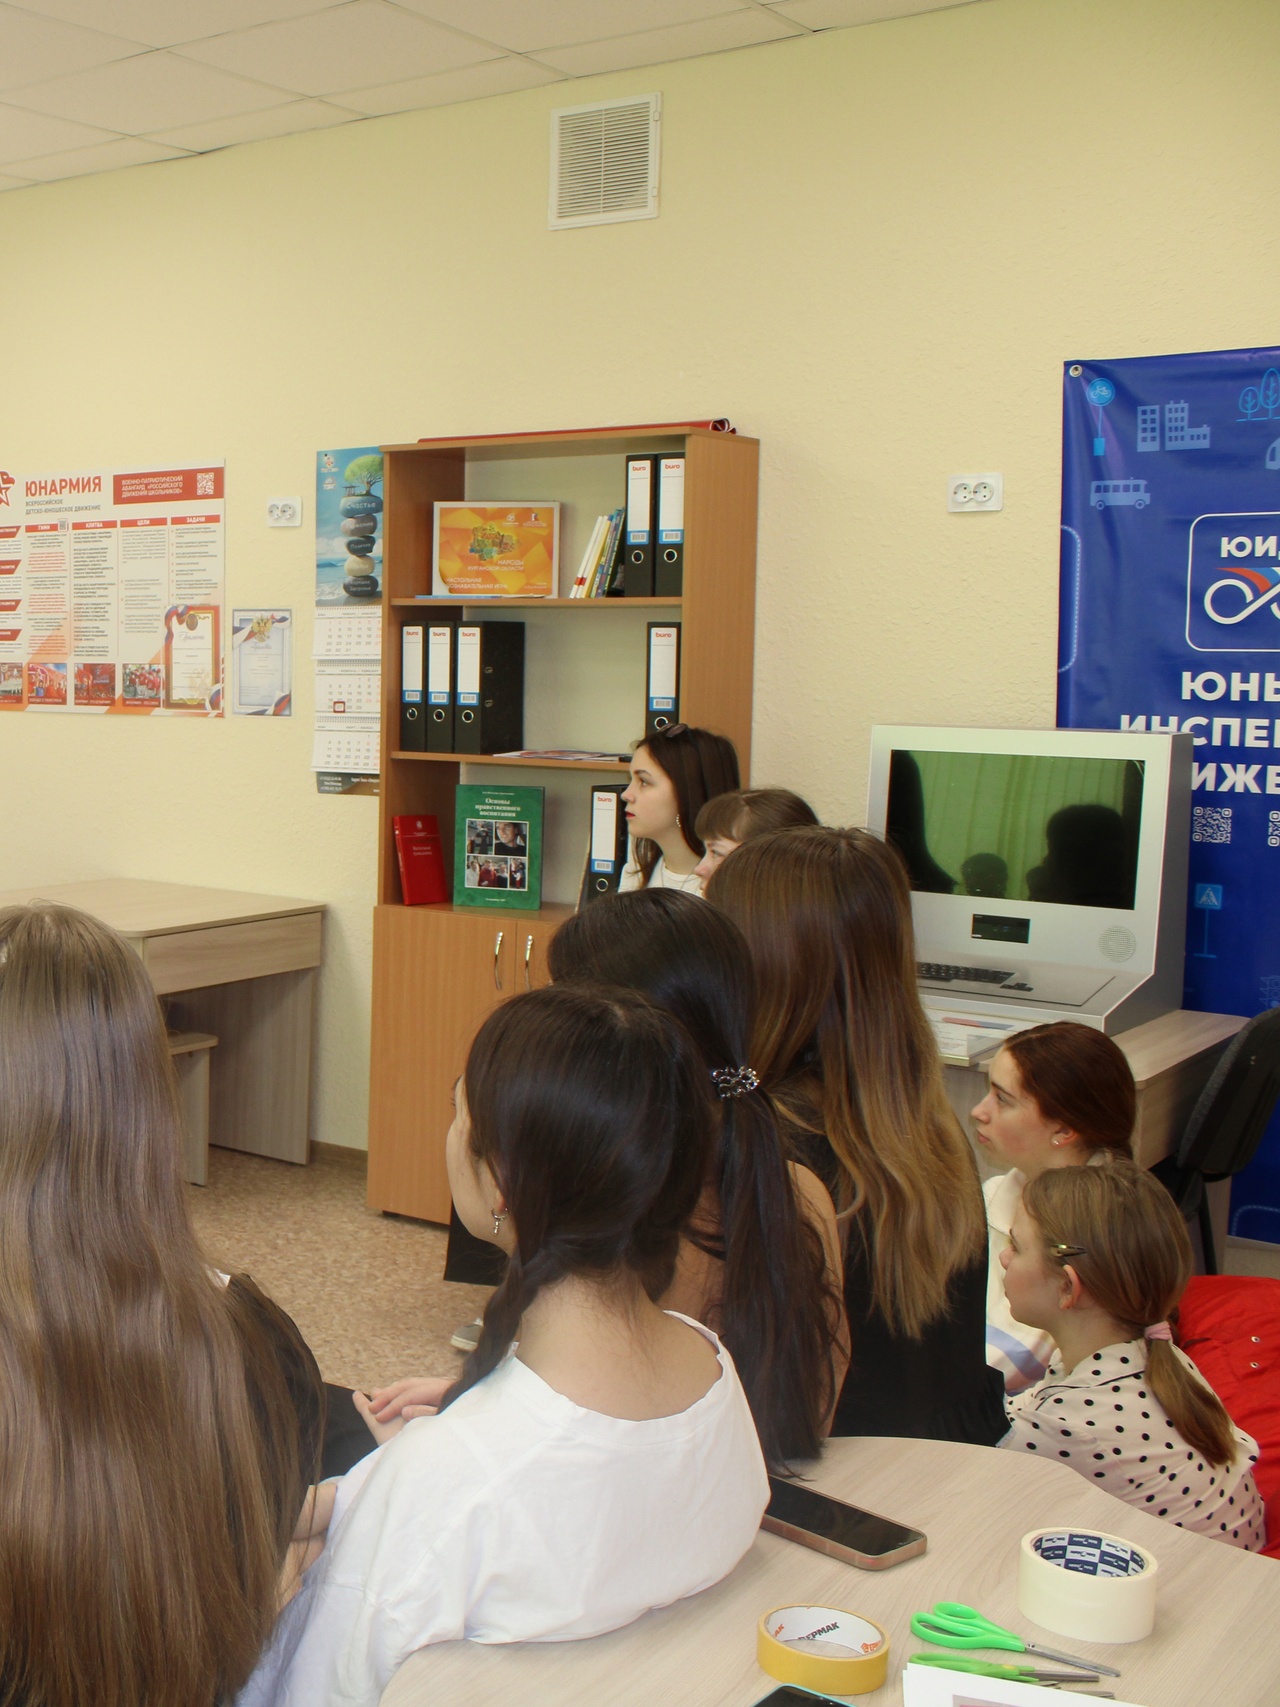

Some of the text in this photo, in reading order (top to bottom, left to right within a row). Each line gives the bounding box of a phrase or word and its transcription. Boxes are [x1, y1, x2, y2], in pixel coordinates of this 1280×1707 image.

[25, 475, 102, 497] ЮНАРМИЯ
[121, 475, 183, 486] ВОЕННО-ПАТРИОТИЧЕСКИЙ
[121, 483, 146, 492] АВАНГАРД
[25, 499, 63, 507] ВСЕРОССИЙСКОЕ
[1220, 535, 1280, 560] ЮИ
[1120, 714, 1280, 748] ИНСПЕ
